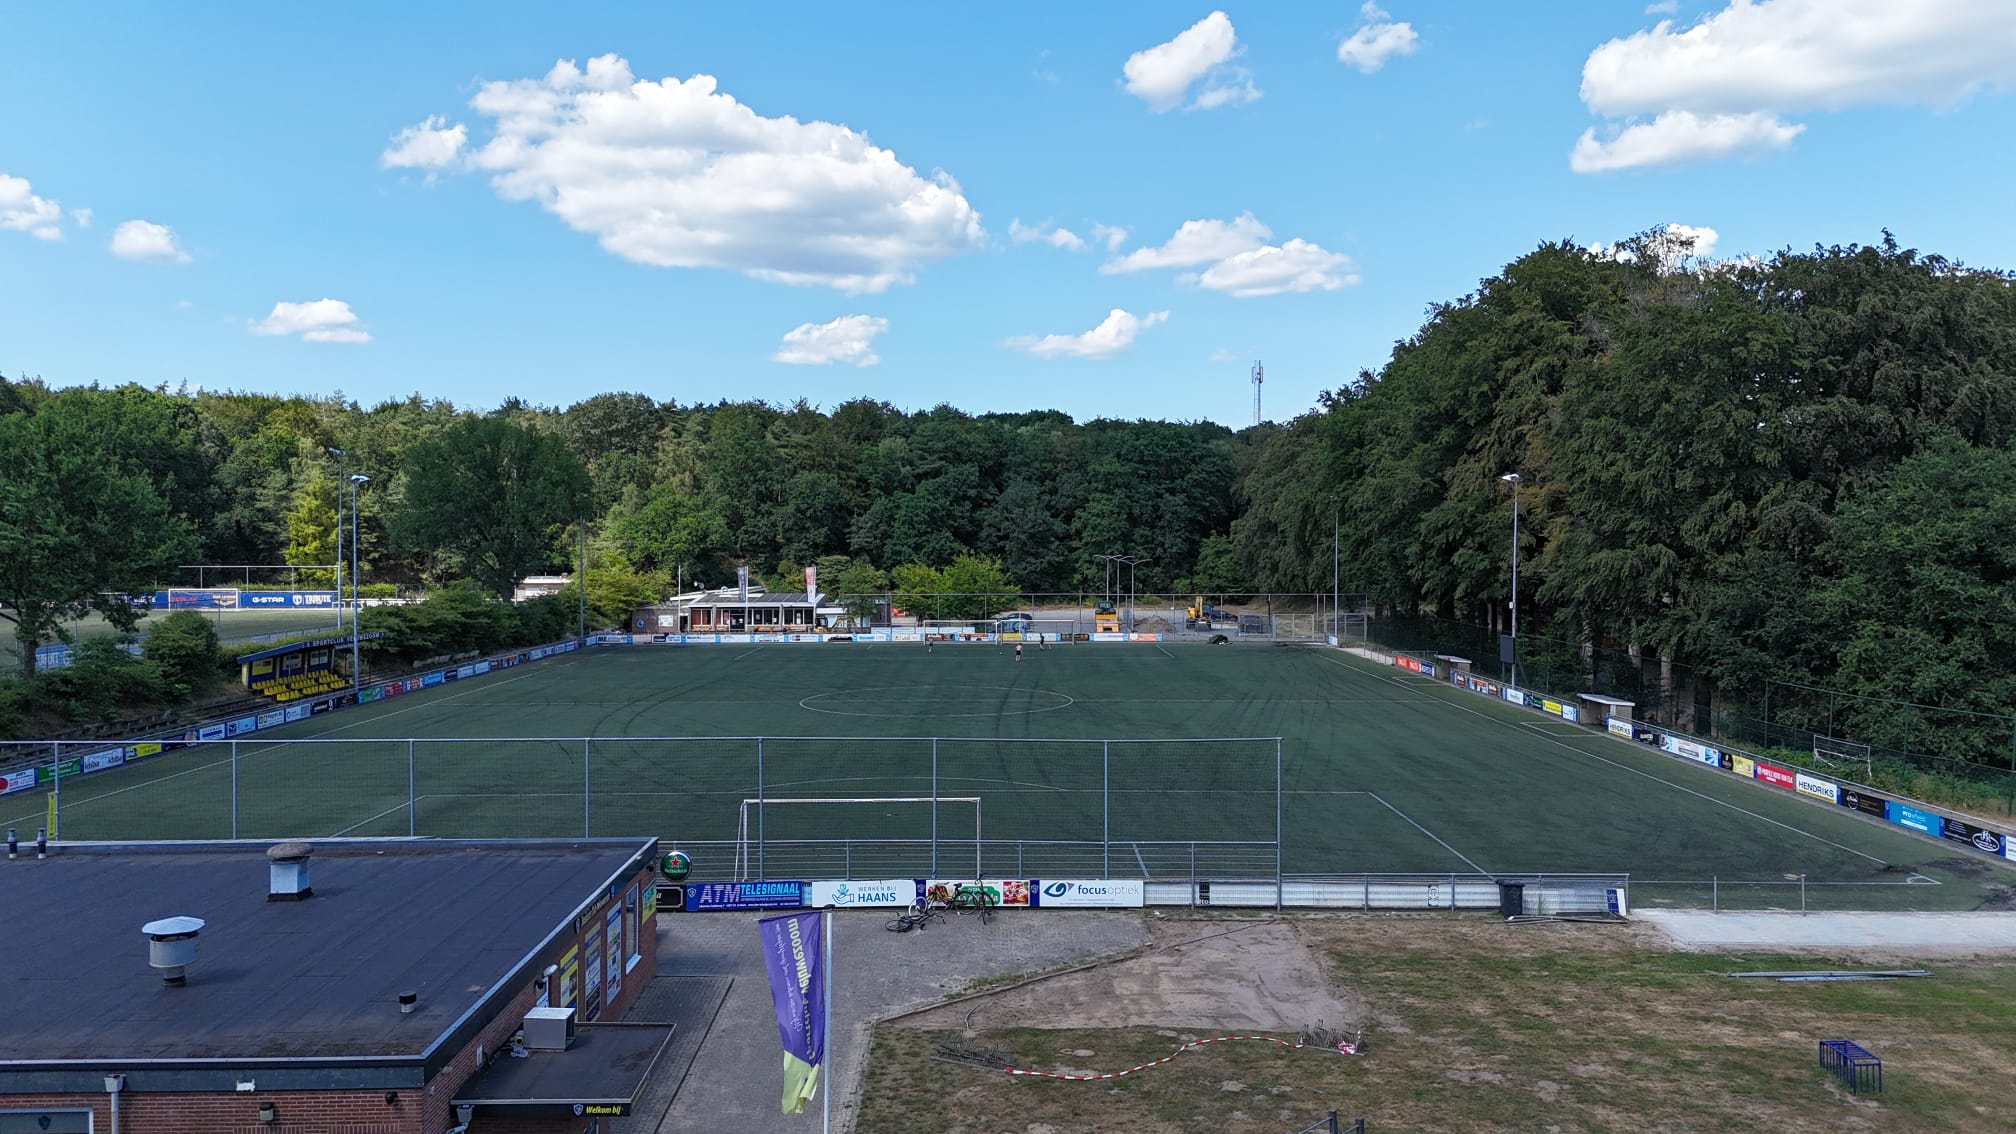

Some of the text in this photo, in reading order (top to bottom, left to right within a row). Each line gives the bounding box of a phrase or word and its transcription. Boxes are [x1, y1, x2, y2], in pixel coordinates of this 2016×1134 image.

[1798, 780, 1835, 798] HENDRIKS
[699, 883, 800, 904] ATM TELESIGNAAL
[858, 892, 897, 902] HAANS
[1077, 884, 1140, 897] focusoptiek
[585, 1105, 622, 1115] Welkom bij
